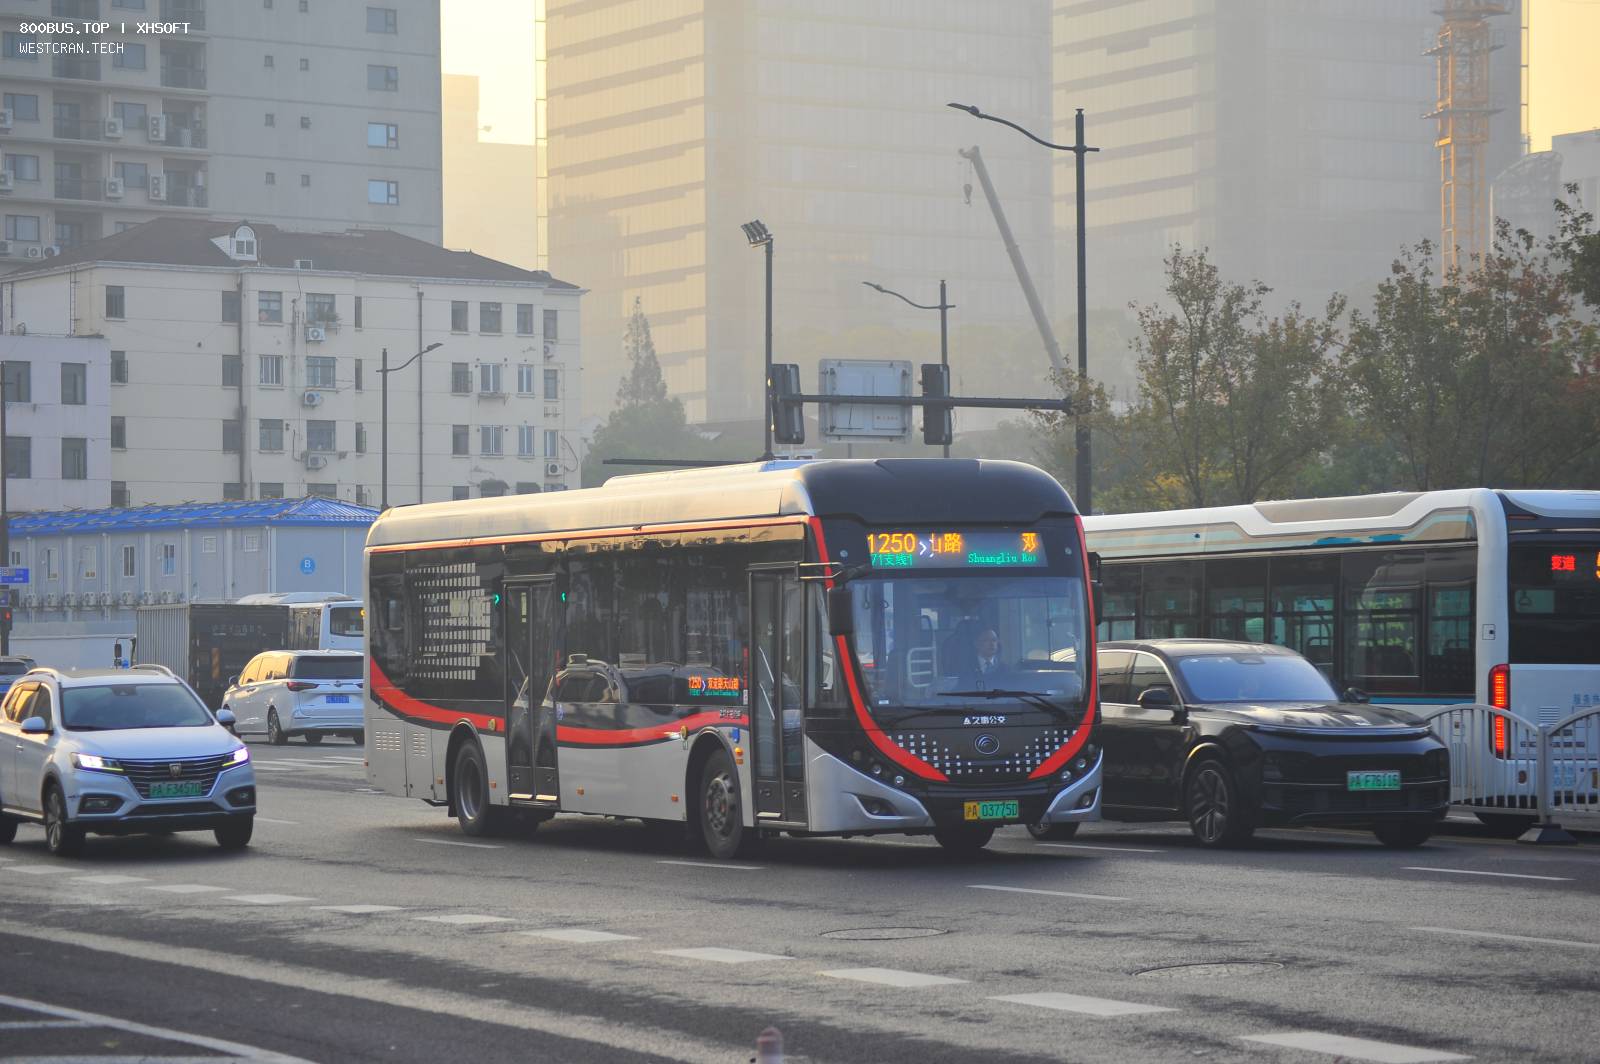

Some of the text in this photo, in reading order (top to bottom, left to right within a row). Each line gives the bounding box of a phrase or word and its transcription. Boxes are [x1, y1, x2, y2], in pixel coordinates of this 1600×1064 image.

[867, 533, 916, 554] 1250
[304, 559, 311, 568] B
[968, 553, 1017, 565] Shuangliu
